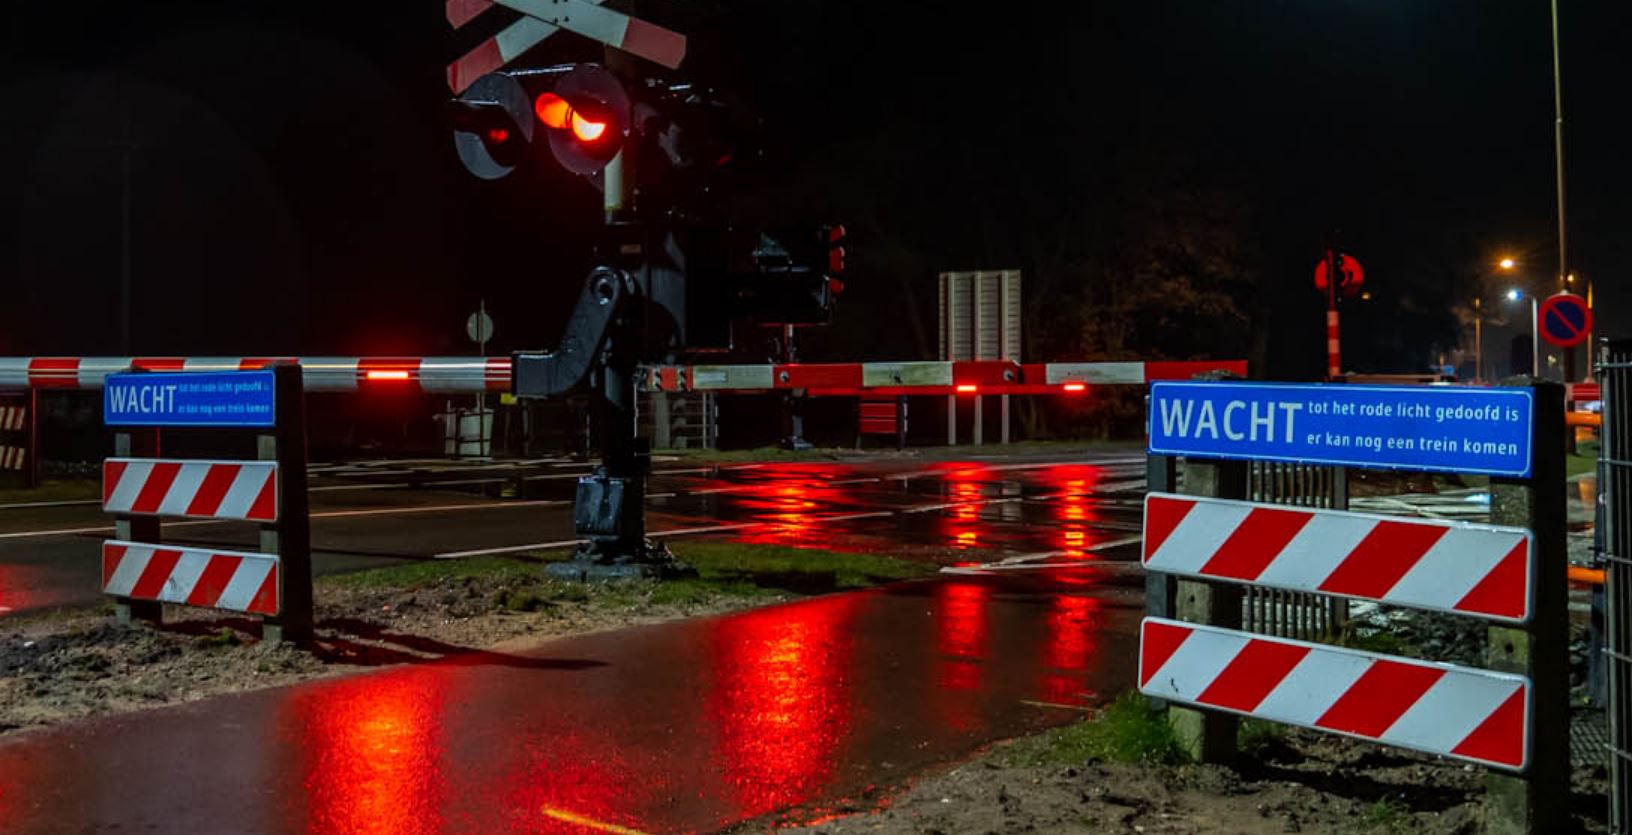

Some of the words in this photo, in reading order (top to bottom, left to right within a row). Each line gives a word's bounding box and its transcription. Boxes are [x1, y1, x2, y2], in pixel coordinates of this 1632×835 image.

[109, 385, 177, 413] WACHT
[1308, 401, 1328, 415] tot
[1332, 400, 1355, 416] het
[1359, 402, 1392, 417] rode
[1397, 402, 1431, 418] licht
[1435, 404, 1500, 423] gedoofd
[1505, 405, 1519, 422] is
[1160, 398, 1303, 443] WACHT
[1307, 433, 1322, 445] er
[1326, 431, 1350, 447] kan
[1355, 435, 1382, 452] nog
[1387, 437, 1414, 450] een
[1420, 436, 1457, 452] trein
[1463, 437, 1517, 455] komen
